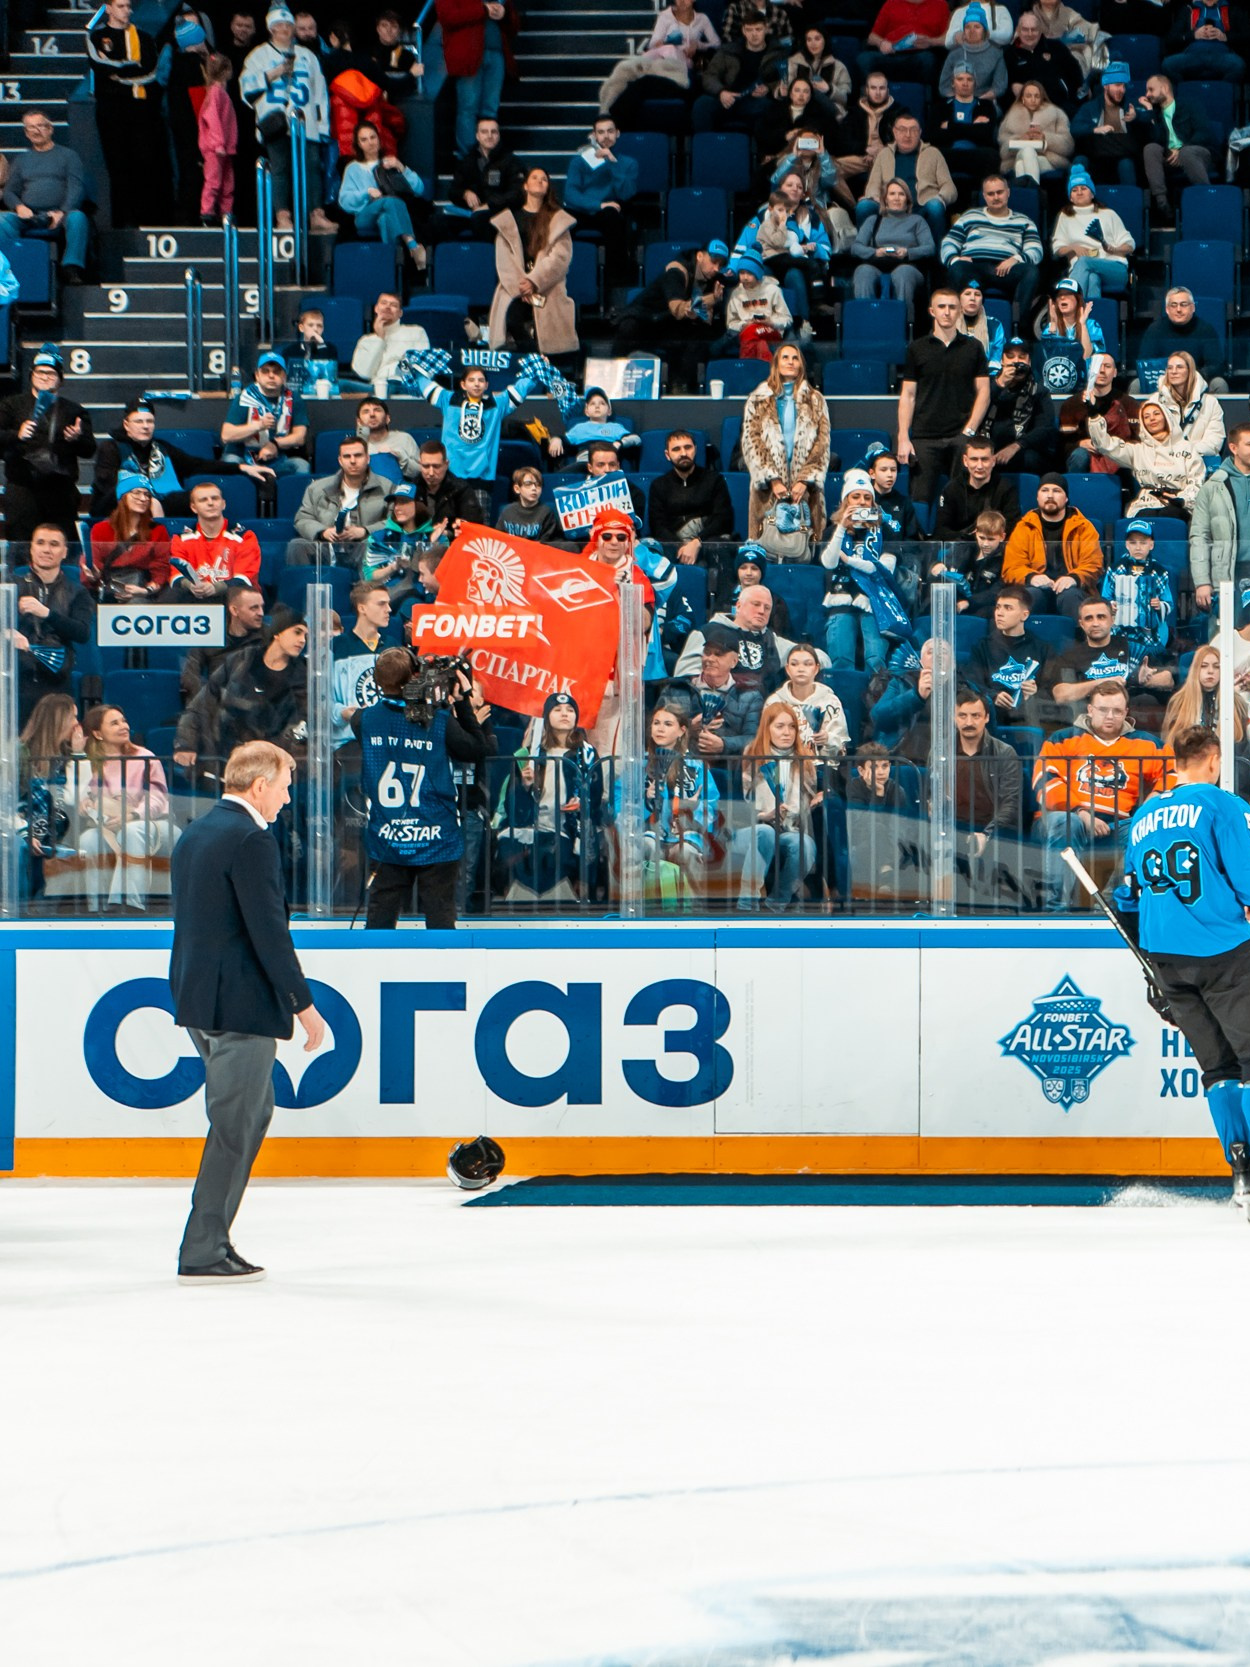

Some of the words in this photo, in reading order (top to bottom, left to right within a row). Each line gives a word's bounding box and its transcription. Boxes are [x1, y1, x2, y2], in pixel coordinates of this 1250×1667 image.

[31, 37, 58, 55] 14
[147, 234, 177, 258] 10
[272, 235, 294, 258] 10
[108, 288, 127, 313] 9
[244, 289, 259, 313] 9
[70, 349, 91, 374] 8
[209, 349, 225, 374] 8
[415, 614, 536, 639] FONBET
[470, 649, 578, 697] СПАРТАК
[388, 736, 399, 747] TV
[377, 760, 425, 808] 67
[1131, 804, 1203, 847] KHAFIZOV
[1043, 1013, 1090, 1023] FONBET
[1031, 1054, 1105, 1063] NOVOSIBIRSK
[1052, 1065, 1082, 1075] 2025
